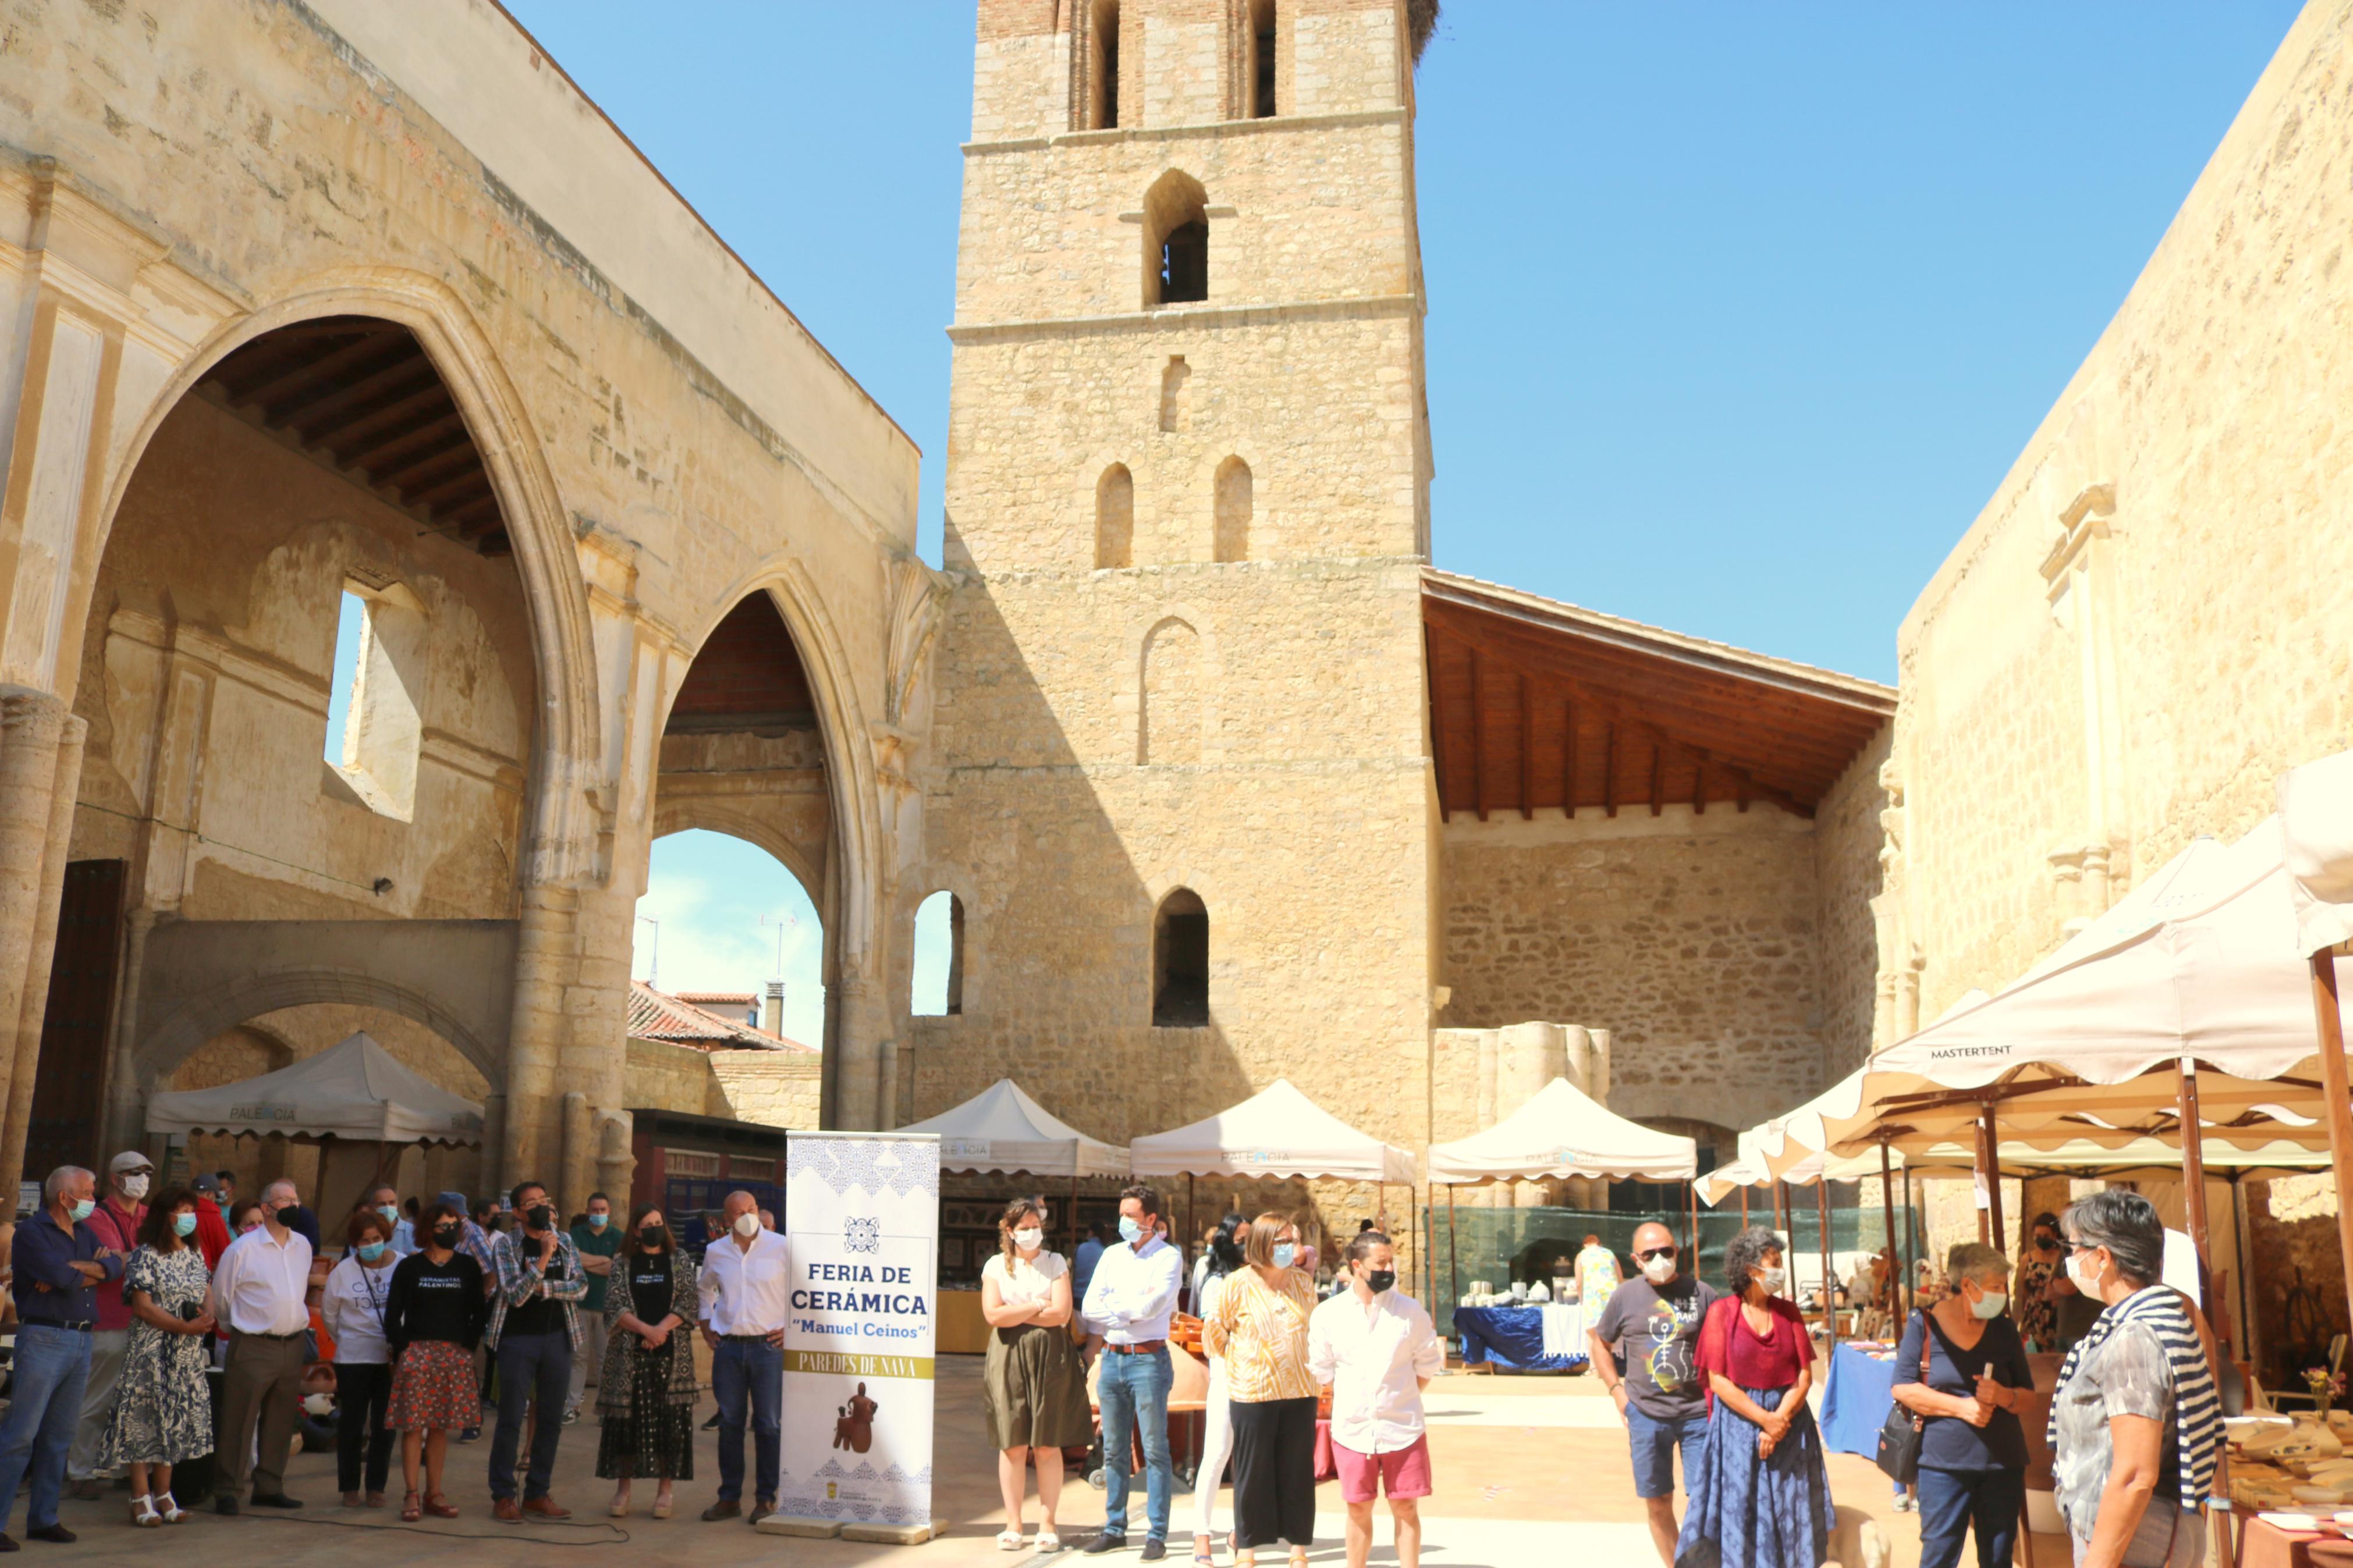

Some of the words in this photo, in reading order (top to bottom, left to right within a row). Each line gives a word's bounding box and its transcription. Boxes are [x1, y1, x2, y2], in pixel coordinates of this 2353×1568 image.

[1932, 1045, 2013, 1059] MASTERTENT
[229, 1107, 296, 1121] PALENCIA
[1220, 1151, 1291, 1162] PALENCIA
[808, 1263, 875, 1282] FERIA
[881, 1267, 911, 1283] DE
[791, 1287, 928, 1315] CERÁMICA
[798, 1352, 857, 1374] PAREDES
[860, 1355, 878, 1375] DE
[881, 1357, 915, 1377] NAVA
